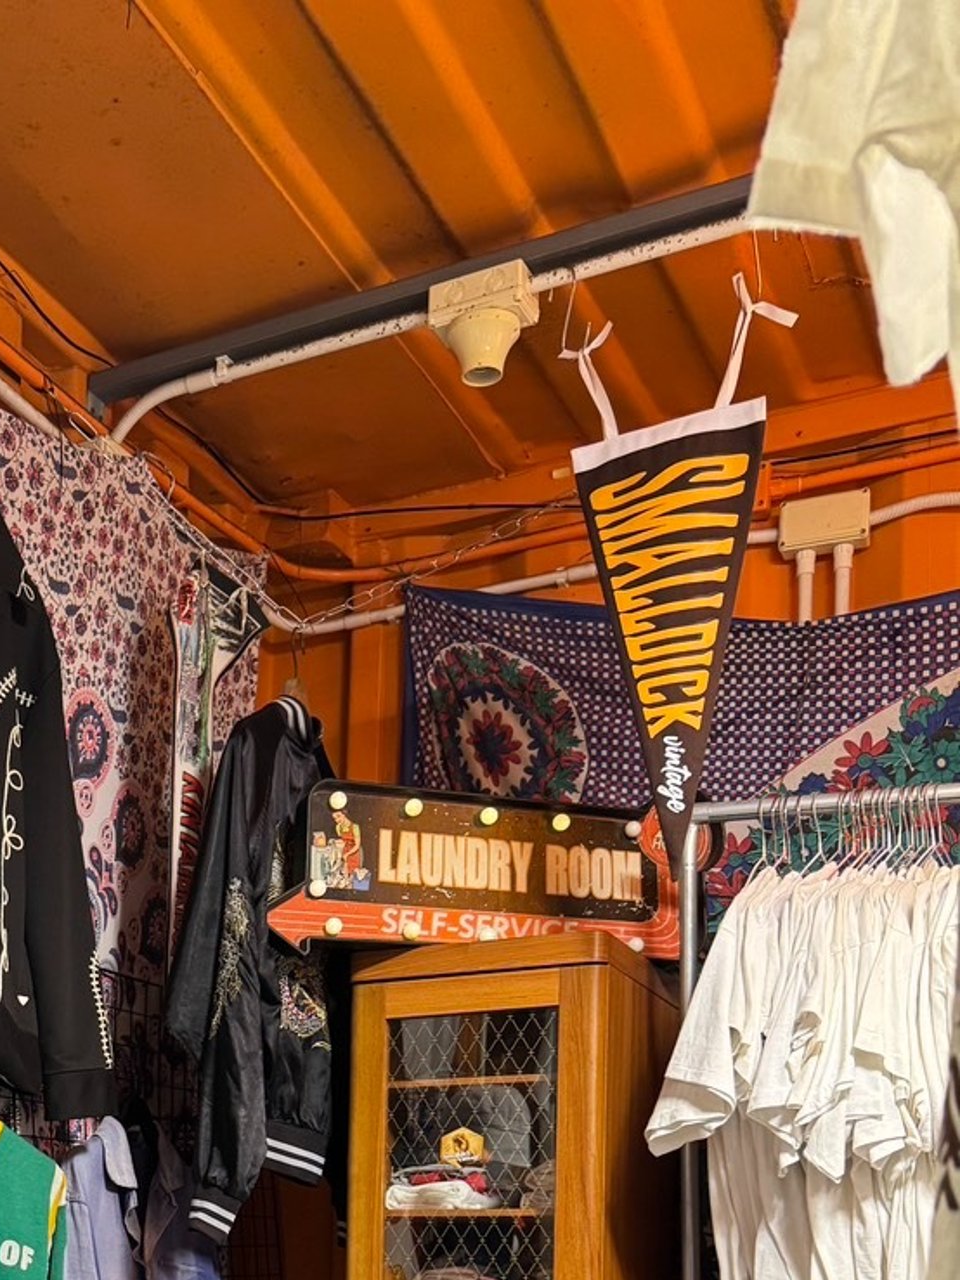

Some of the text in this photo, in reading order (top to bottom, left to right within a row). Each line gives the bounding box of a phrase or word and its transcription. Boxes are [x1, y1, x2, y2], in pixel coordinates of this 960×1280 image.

[588, 452, 751, 741] SMALLDICK
[656, 732, 695, 815] vintage
[377, 827, 642, 902] LAUNDRY ROOM
